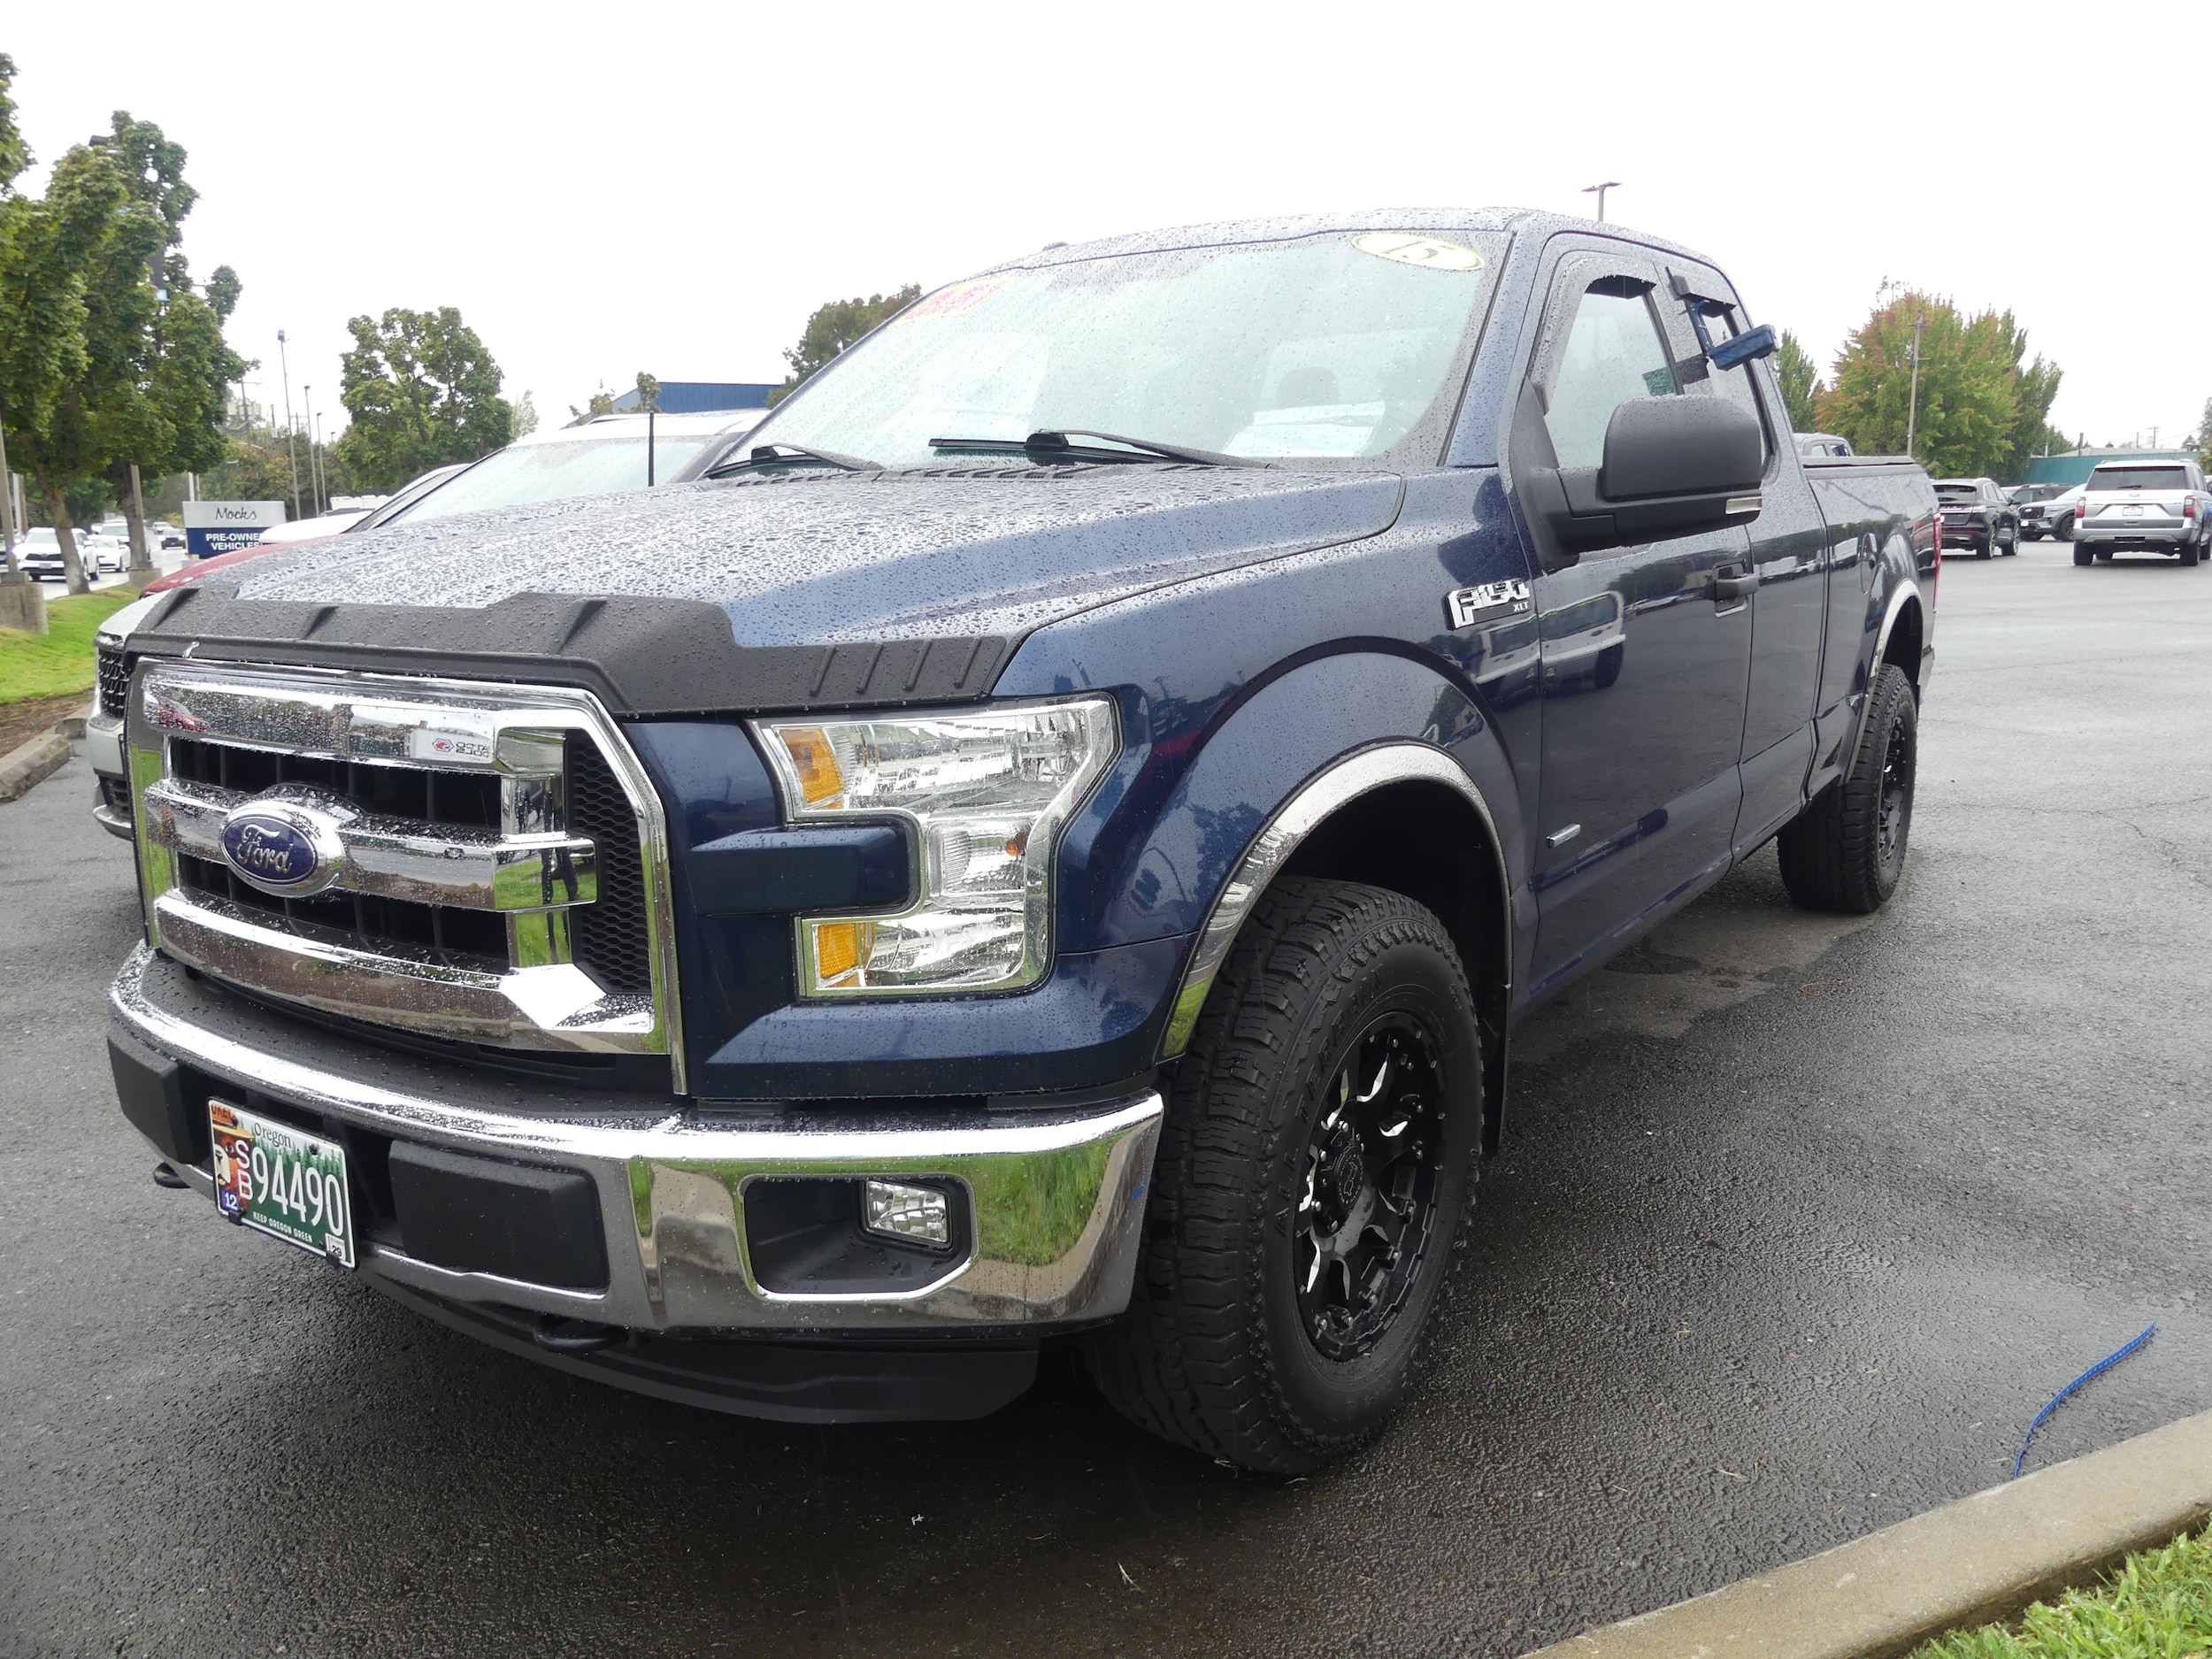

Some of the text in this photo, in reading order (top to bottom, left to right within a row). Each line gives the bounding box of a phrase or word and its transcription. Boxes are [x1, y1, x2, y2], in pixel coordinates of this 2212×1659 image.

[206, 533, 259, 541] PRE-OWNE
[1513, 602, 1529, 612] XLT
[235, 824, 294, 873] Ford
[254, 1122, 293, 1148] Oregon
[224, 1192, 239, 1210] 12
[251, 1147, 344, 1237] 94490
[253, 1211, 268, 1224] KEEP
[268, 1217, 292, 1235] OREGON
[293, 1227, 313, 1243] GREEN
